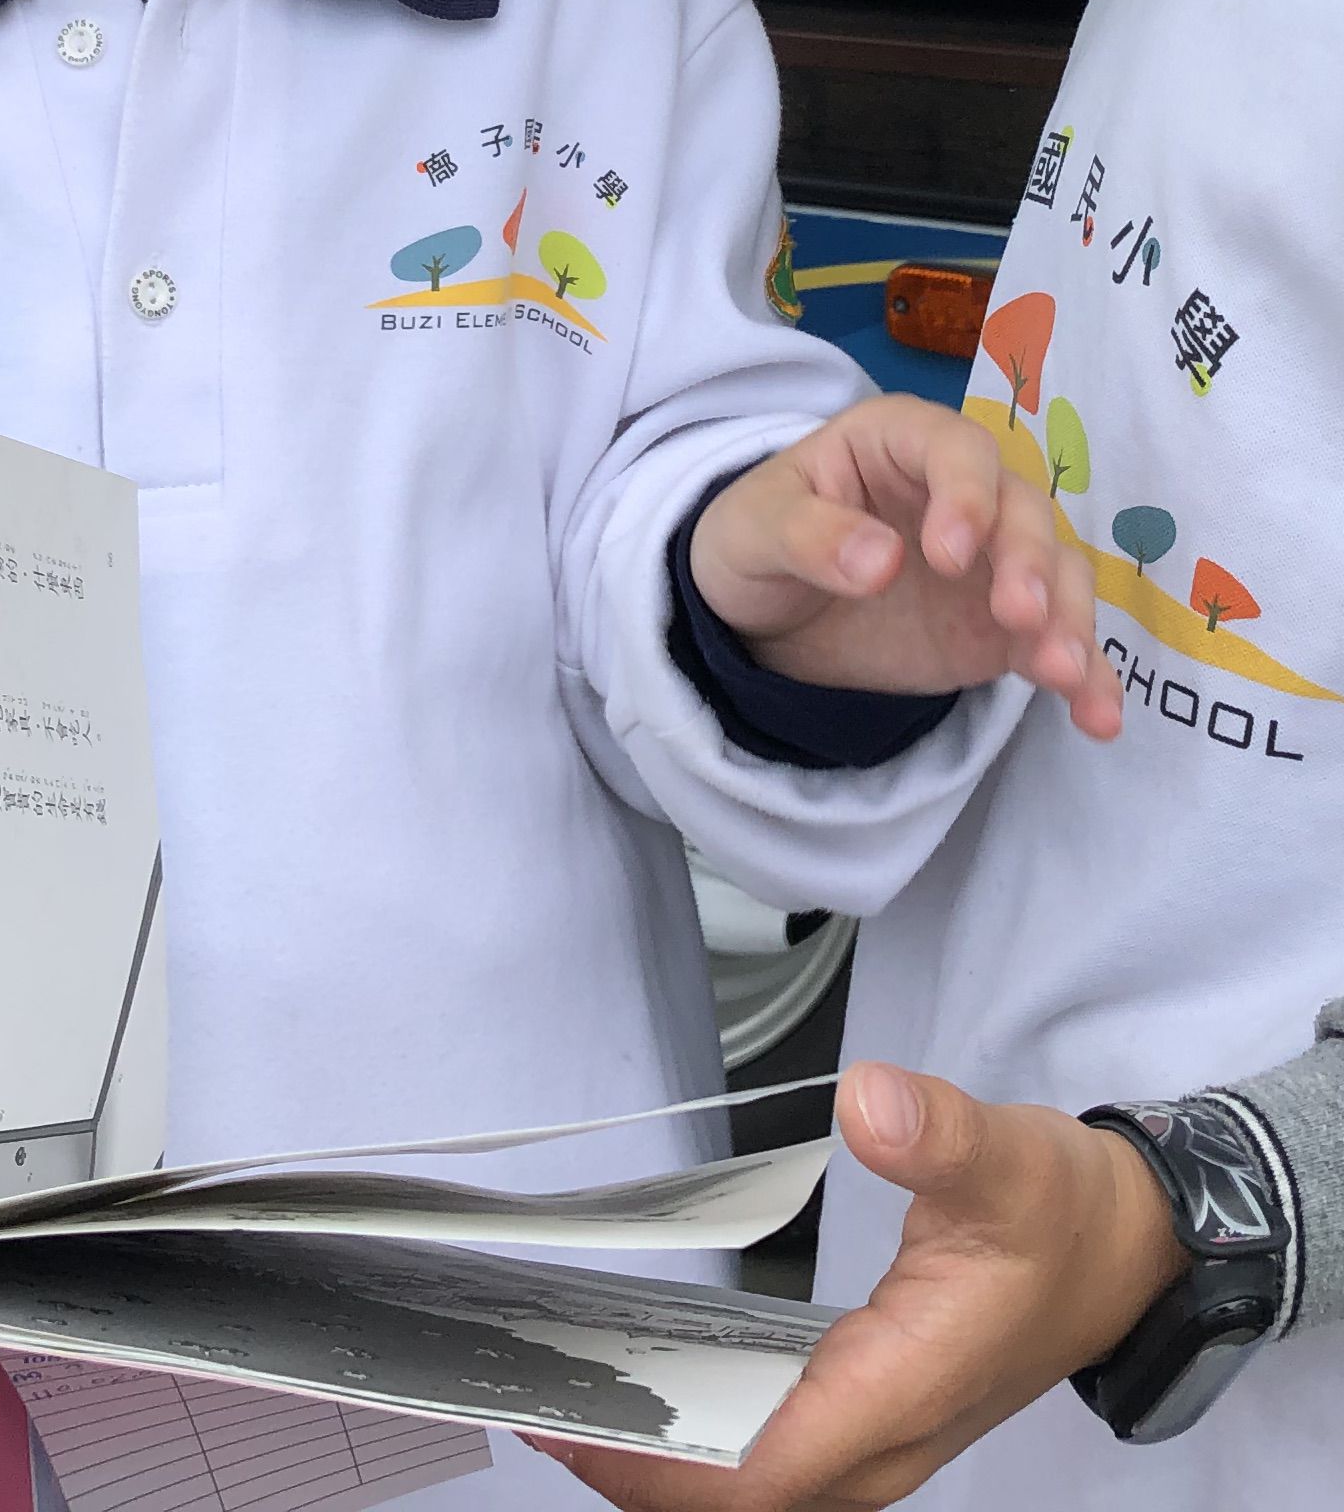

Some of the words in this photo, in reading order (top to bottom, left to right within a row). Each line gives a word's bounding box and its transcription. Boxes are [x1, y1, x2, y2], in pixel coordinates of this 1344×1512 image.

[142, 269, 177, 294] SPORTS
[380, 314, 442, 331] BUZI
[514, 304, 593, 355] SCHOOL
[1102, 637, 1305, 762] CHOOL
